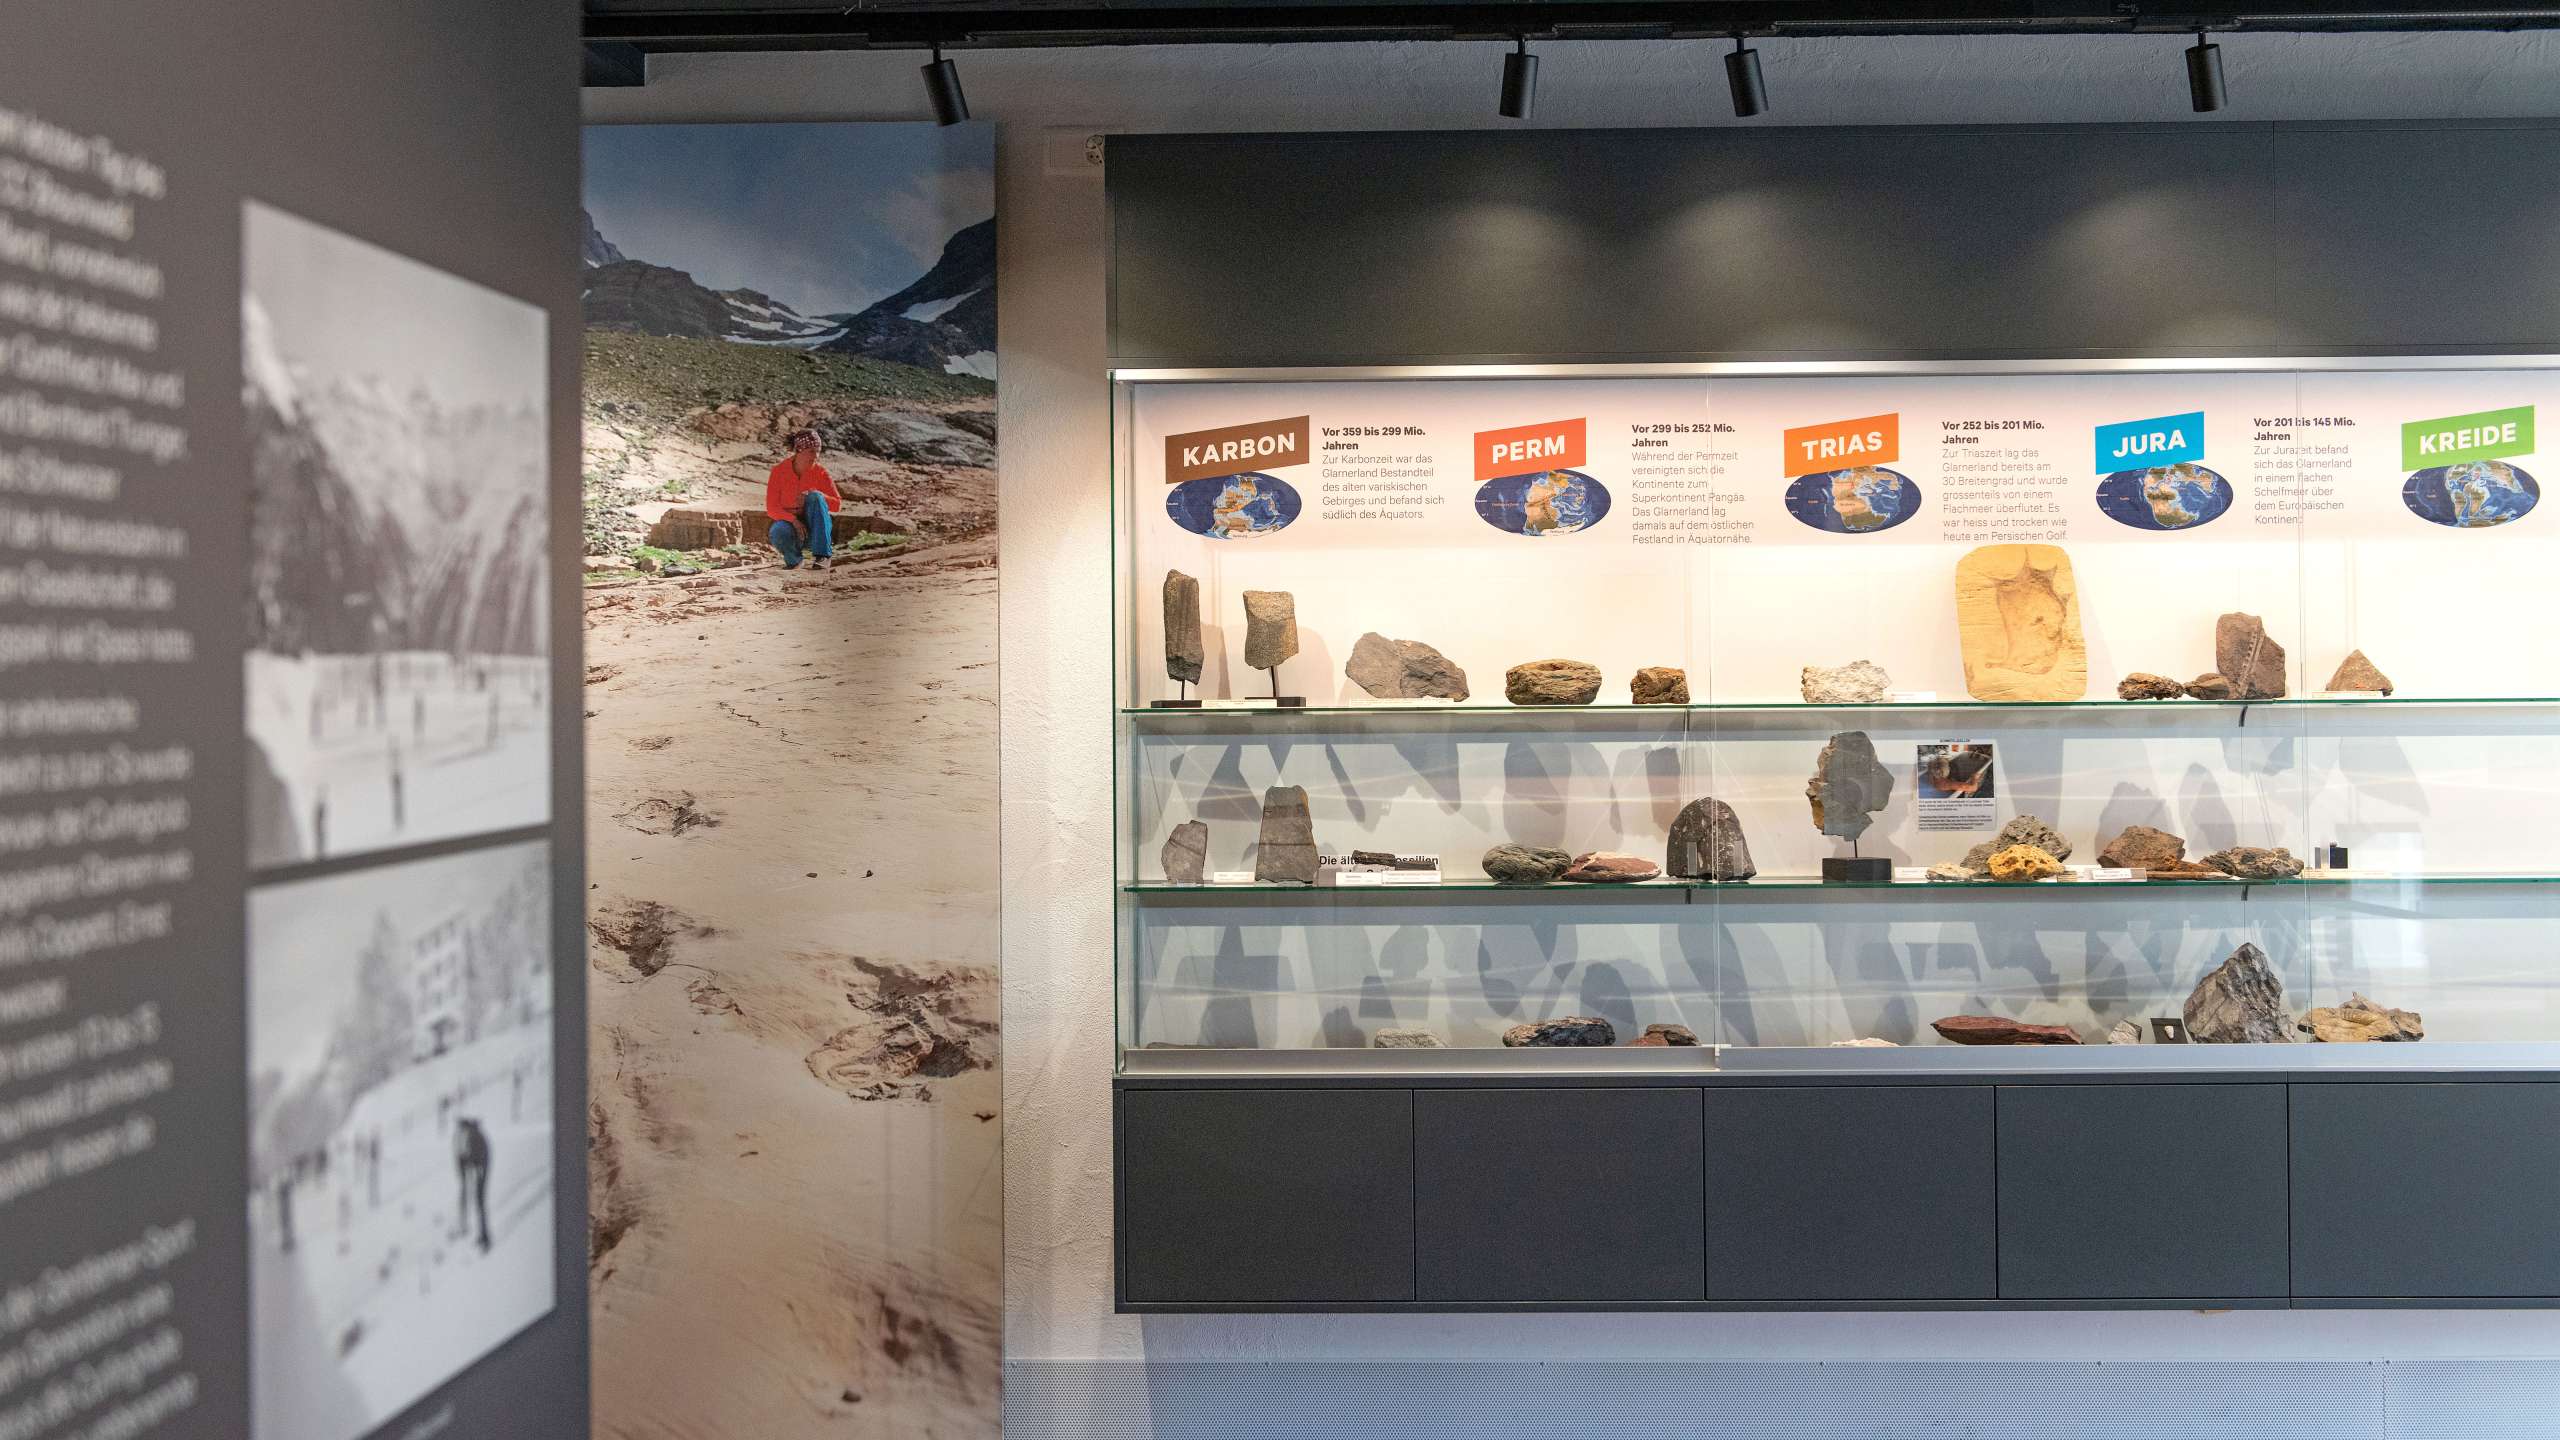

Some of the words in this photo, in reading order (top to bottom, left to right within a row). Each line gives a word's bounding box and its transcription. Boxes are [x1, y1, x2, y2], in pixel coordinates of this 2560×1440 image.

[1942, 422, 1960, 430] Vor
[1985, 421, 1999, 429] bis
[2002, 421, 2020, 429] 201
[2023, 421, 2045, 429] Mio.
[2254, 418, 2272, 426] Vor
[2275, 418, 2292, 426] 201
[2313, 418, 2331, 426] 145
[2334, 417, 2355, 426] Mio.
[1322, 428, 1340, 436] Vor
[1343, 428, 1361, 436] 359
[1364, 427, 1379, 435] bis
[1382, 427, 1401, 435] 299
[1404, 427, 1425, 435] Mio.
[1632, 425, 1649, 433] Vor
[1674, 424, 1689, 432] bis
[1692, 424, 1710, 432] 252
[1714, 424, 1735, 432] Mio.
[1942, 435, 1979, 443] Jahren
[2254, 432, 2290, 440] Jahren
[2420, 422, 2517, 455] KREIDE
[1322, 442, 1358, 450] Jahren
[1632, 439, 1668, 447] Jahren
[1801, 431, 1883, 461] TRIAS
[2112, 429, 2187, 458] JURA
[1183, 432, 1295, 467] KARBON
[1492, 434, 1566, 464] PERM
[1943, 449, 1958, 458] Zur
[1962, 449, 2002, 457] Triaszeit
[2005, 449, 2019, 459] lag
[2022, 448, 2039, 457] das
[2254, 446, 2270, 454] Zur
[2315, 445, 2348, 454] befand
[1322, 455, 1338, 464] Zur
[1342, 455, 1392, 463] Karbonzeit
[1396, 455, 1412, 463] war
[1416, 454, 1432, 463] das
[1632, 452, 1674, 460] Während
[1677, 452, 1693, 460] der
[1697, 451, 1738, 460] Permzeit
[1943, 463, 1998, 472] Glarnerland
[2001, 463, 2033, 471] bereits
[2254, 460, 2273, 468] sich
[2276, 460, 2293, 468] das
[2296, 459, 2352, 468] Glarnerland
[1322, 469, 1378, 478] Glarnerland
[1381, 468, 1433, 477] Bestandteil
[1632, 467, 1685, 476] vereinigten
[1688, 466, 1707, 474] sich
[1710, 466, 1725, 474] die
[1959, 476, 2013, 487] Breitengrad
[2017, 476, 2034, 484] und
[2038, 476, 2068, 484] wurde
[2255, 474, 2262, 482] in
[2266, 474, 2294, 482] einem
[1323, 483, 1339, 491] des
[1343, 483, 1365, 491] alten
[1369, 482, 1427, 490] variskischen
[1633, 480, 1684, 488] Kontinente
[1943, 490, 2000, 501] grossenteils
[2004, 491, 2020, 499] von
[2254, 487, 2308, 496] Schelfmeer
[2312, 487, 2334, 495] über
[1322, 496, 1365, 507] Gebirges
[1369, 496, 1386, 504] und
[1390, 496, 1422, 504] befand
[1425, 495, 1444, 504] sich
[1632, 492, 1706, 504] Superkontinent
[1944, 504, 1993, 513] Flachmeer
[2049, 504, 2060, 512] Es
[2255, 502, 2275, 510] dem
[1323, 510, 1356, 519] südlich
[1360, 510, 1376, 518] des
[1380, 509, 1424, 520] Äquators.
[1633, 508, 1650, 516] Das
[1654, 507, 1708, 516] Glarnerland
[1712, 507, 1726, 517] lag
[1633, 522, 1666, 530] damals
[1669, 521, 1686, 530] auf
[1687, 521, 1708, 529] dem
[1944, 519, 1960, 527] war
[1963, 518, 1987, 526] heiss
[1991, 518, 2008, 526] und
[2012, 518, 2048, 526] trocken
[2051, 518, 2067, 526] wie
[1633, 535, 1673, 544] Festland
[1677, 535, 1684, 543] in
[1688, 533, 1752, 545] Äquatornähe.
[1944, 532, 1970, 541] heute
[1974, 533, 1988, 541] am
[1992, 531, 2043, 540] Persischen
[2046, 531, 2067, 540] Golf.
[1319, 855, 1337, 865] Die
